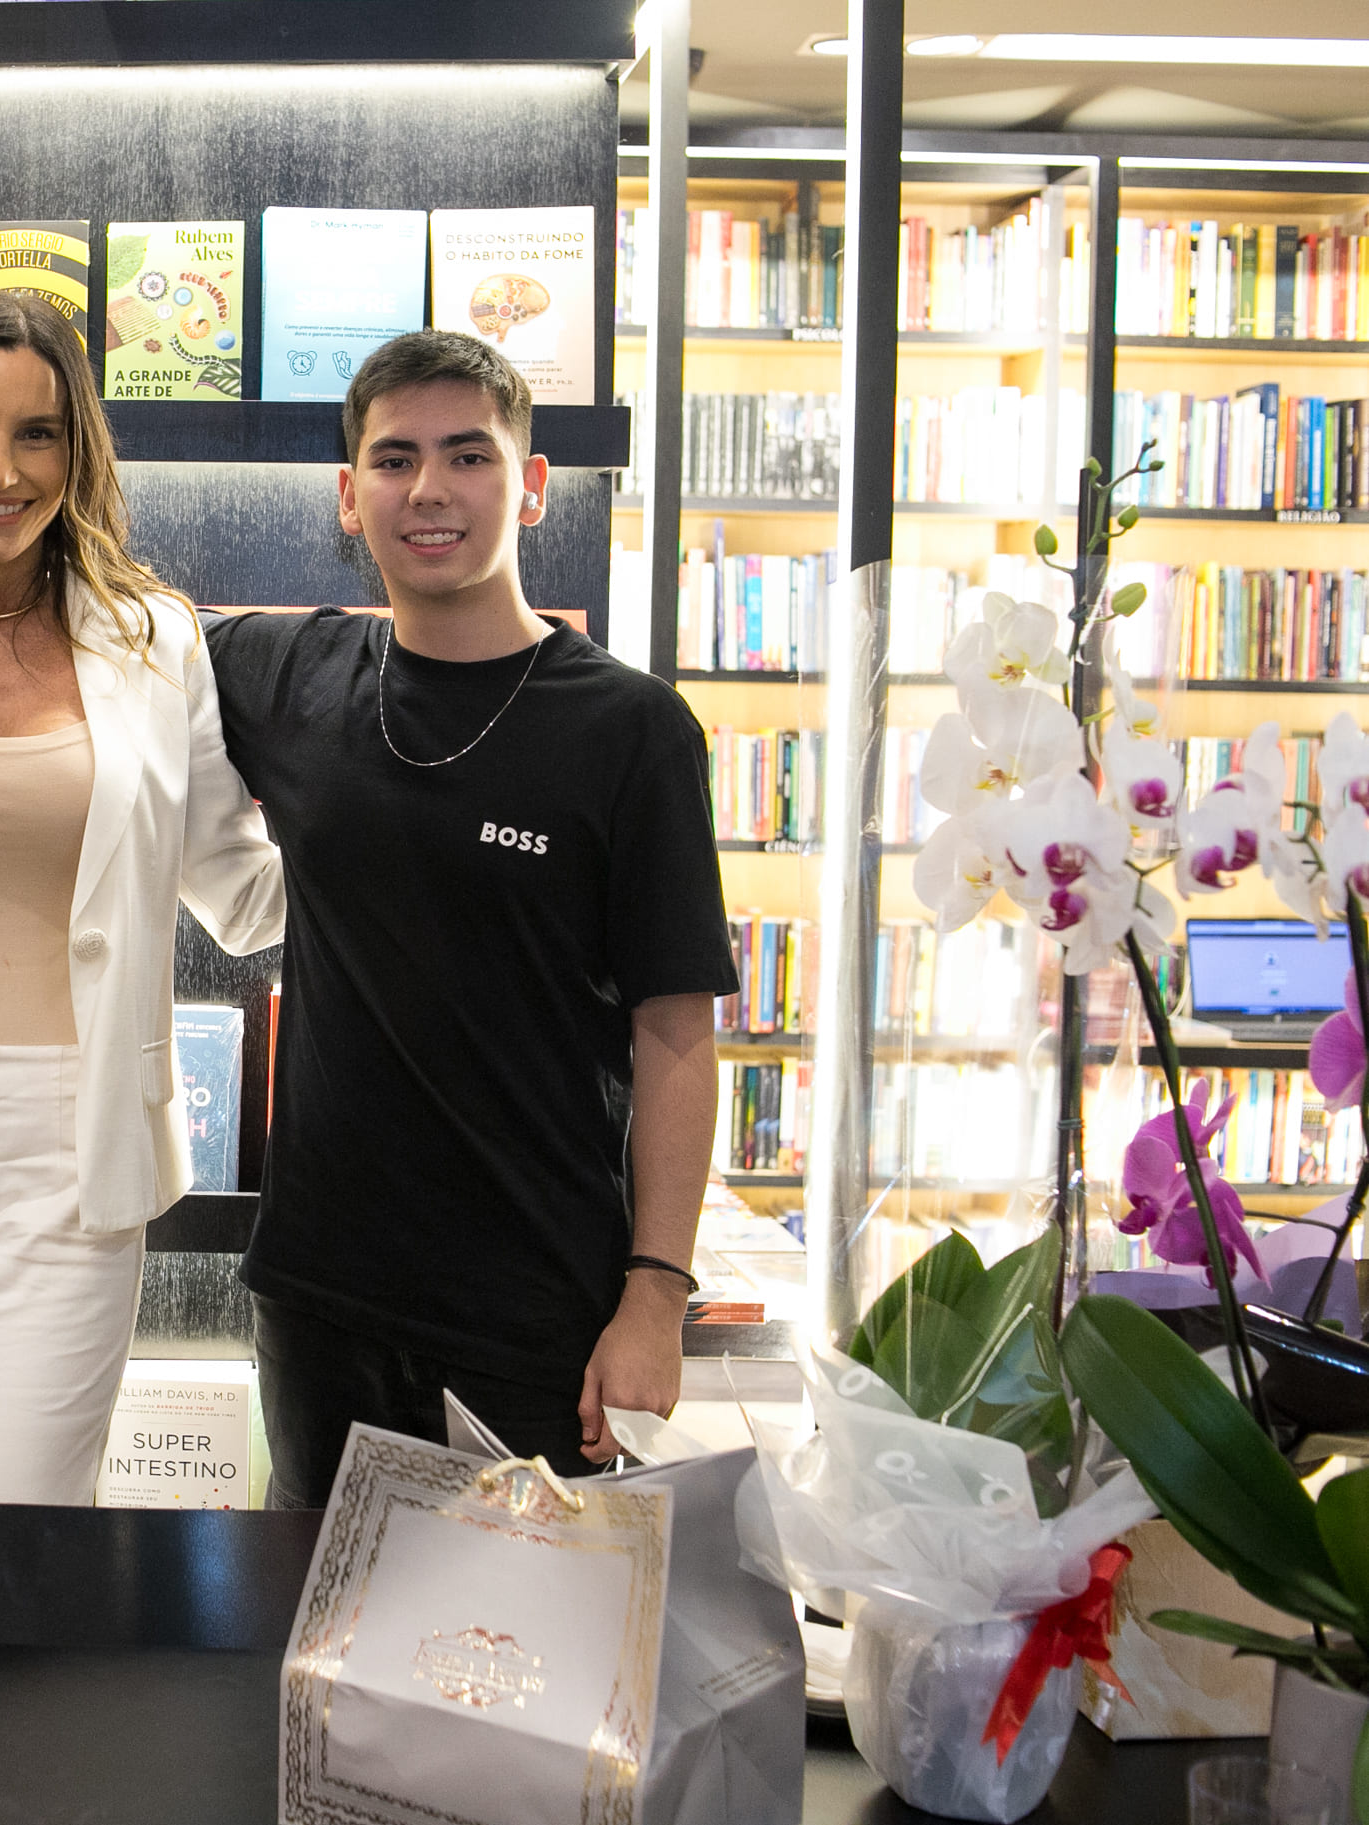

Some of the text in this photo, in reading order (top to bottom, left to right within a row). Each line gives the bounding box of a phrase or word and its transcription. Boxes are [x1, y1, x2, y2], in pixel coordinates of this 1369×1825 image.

[20, 231, 64, 252] SERGIO
[175, 229, 234, 244] Rubem
[446, 232, 584, 244] DESCONSTRUINDO
[191, 246, 233, 261] Alves
[445, 251, 456, 260] O
[520, 250, 539, 260] DA
[545, 249, 584, 259] FOME
[114, 370, 192, 382] A GRANDE
[114, 385, 173, 398] ARTE DE
[479, 821, 550, 855] BOSS
[118, 1387, 239, 1402] ILLIAM DAVIS, M.D.
[133, 1432, 211, 1452] SUPER
[109, 1457, 237, 1480] INTESTINO
